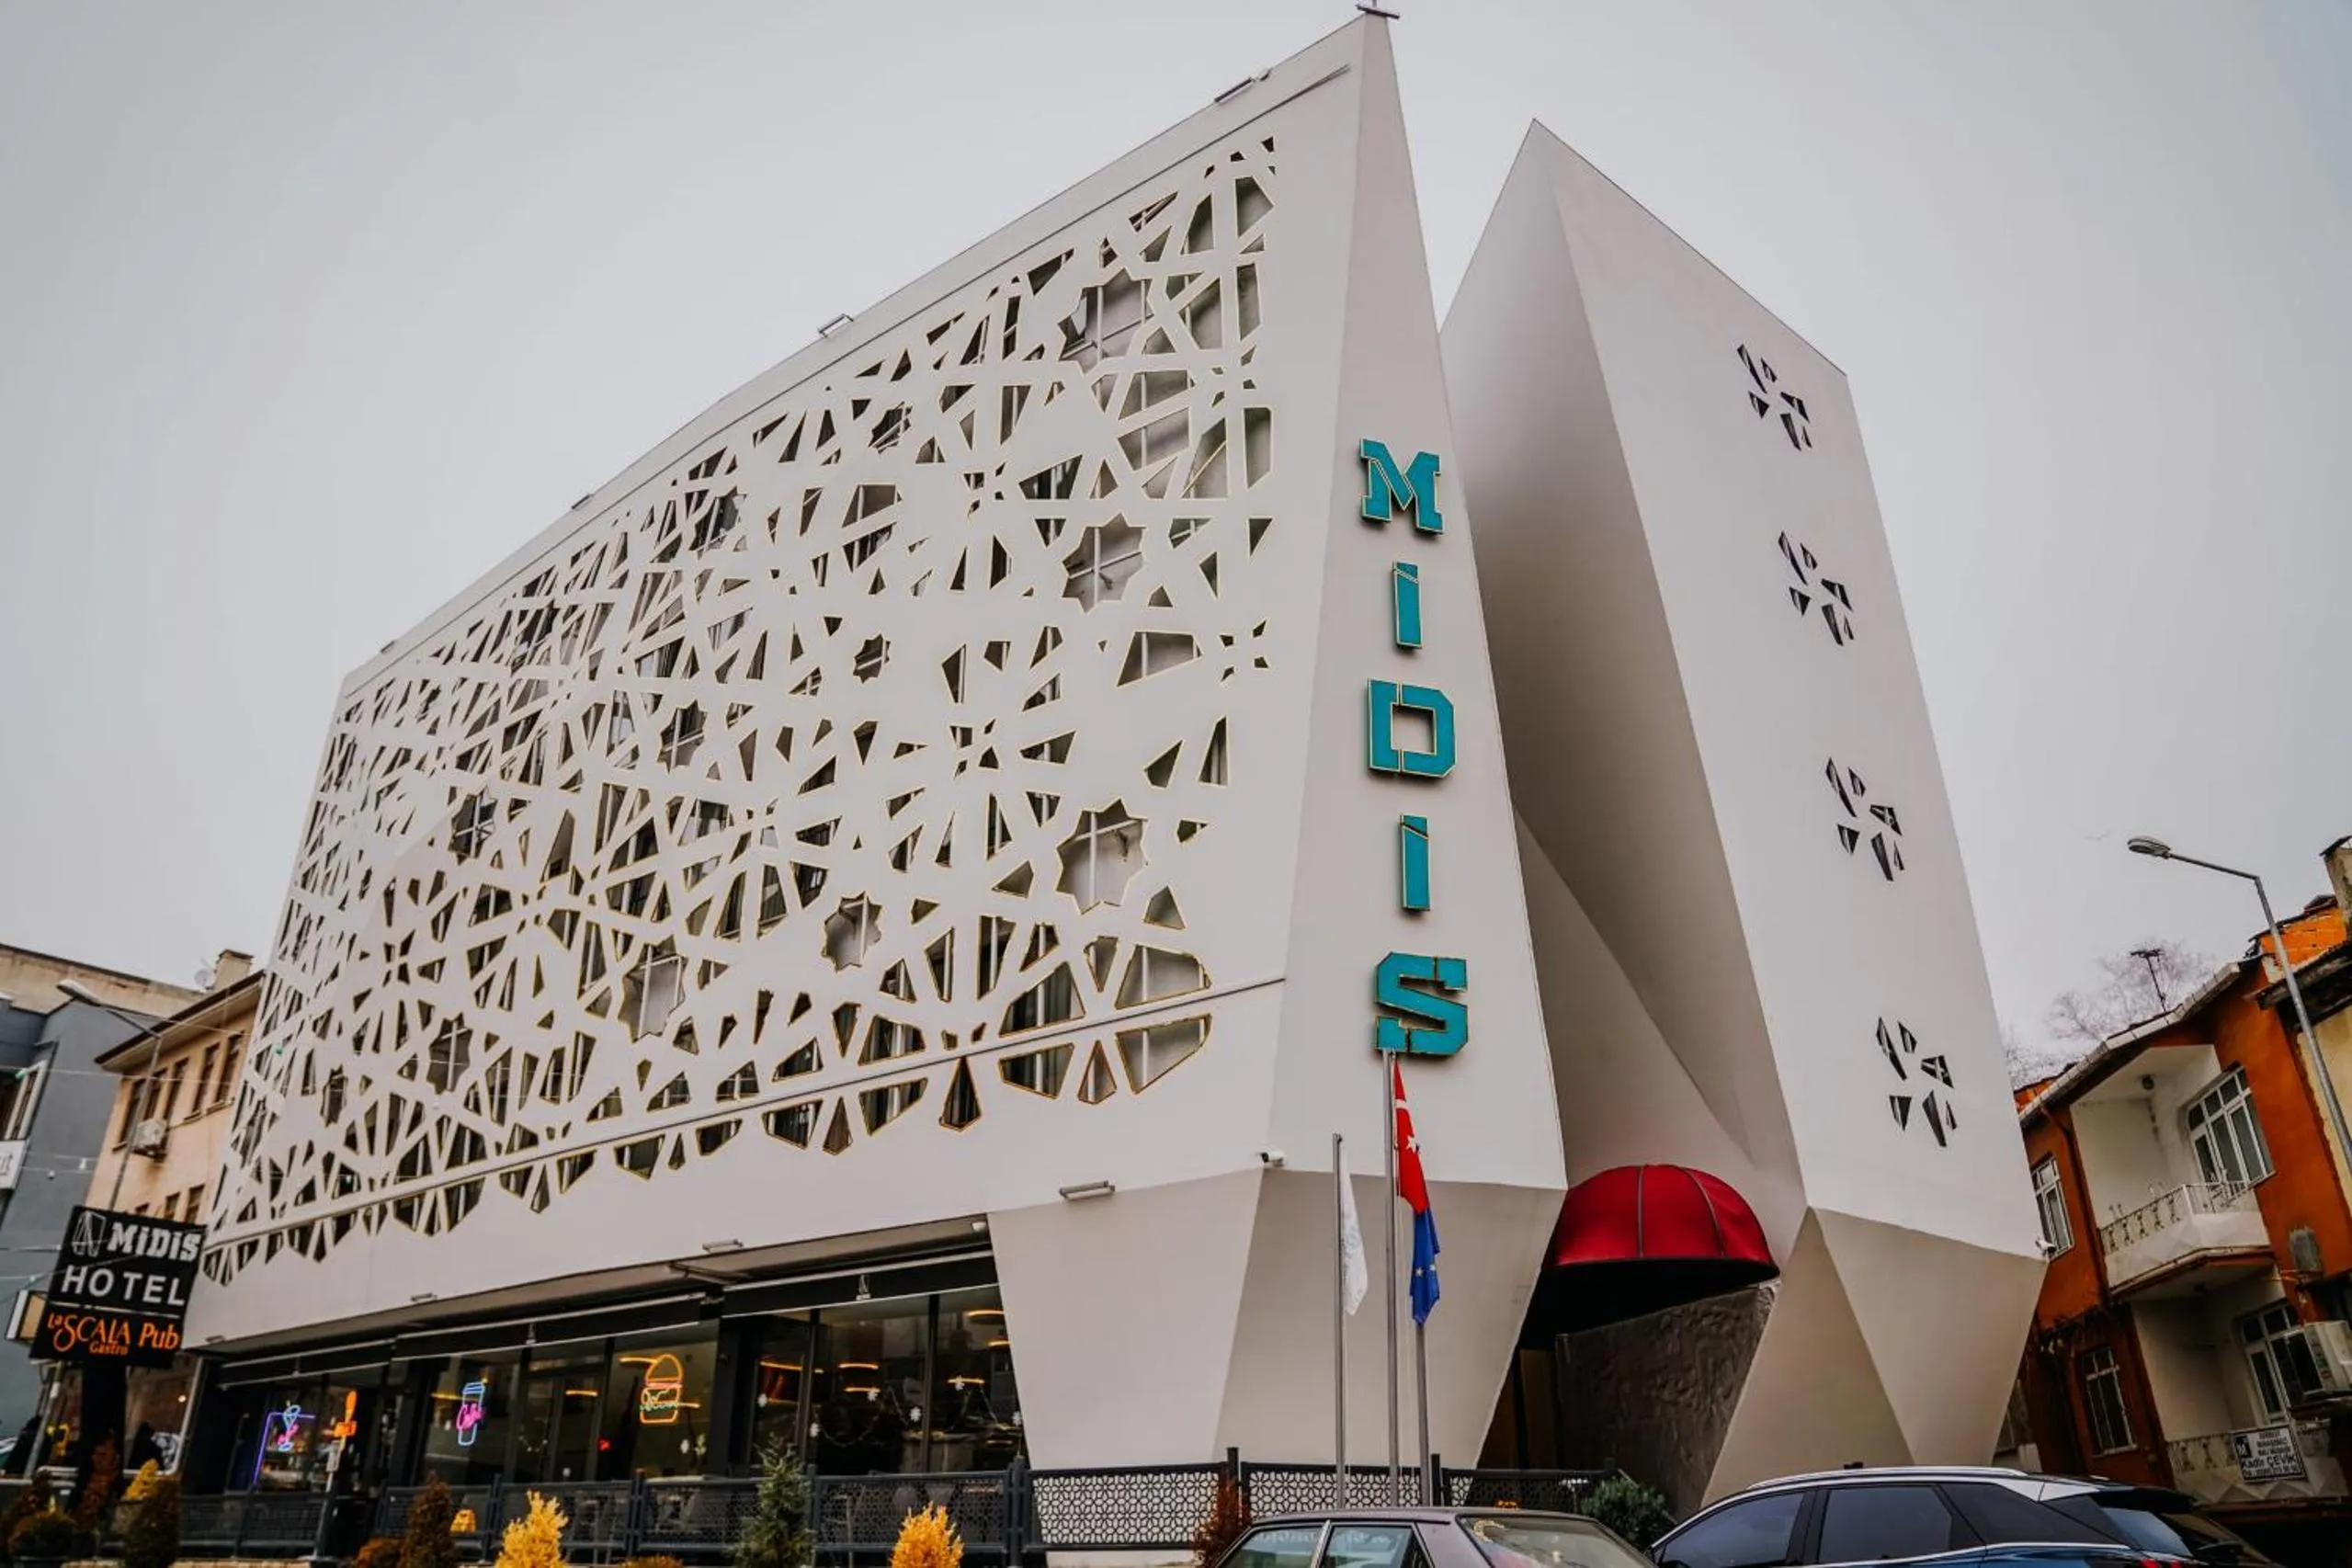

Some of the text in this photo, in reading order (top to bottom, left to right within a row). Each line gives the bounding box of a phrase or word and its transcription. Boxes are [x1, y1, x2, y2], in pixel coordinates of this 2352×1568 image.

[61, 1264, 186, 1306] HOTEL
[52, 1313, 131, 1353] SCALA
[139, 1321, 180, 1350] Pub
[89, 1341, 129, 1356] Gastro
